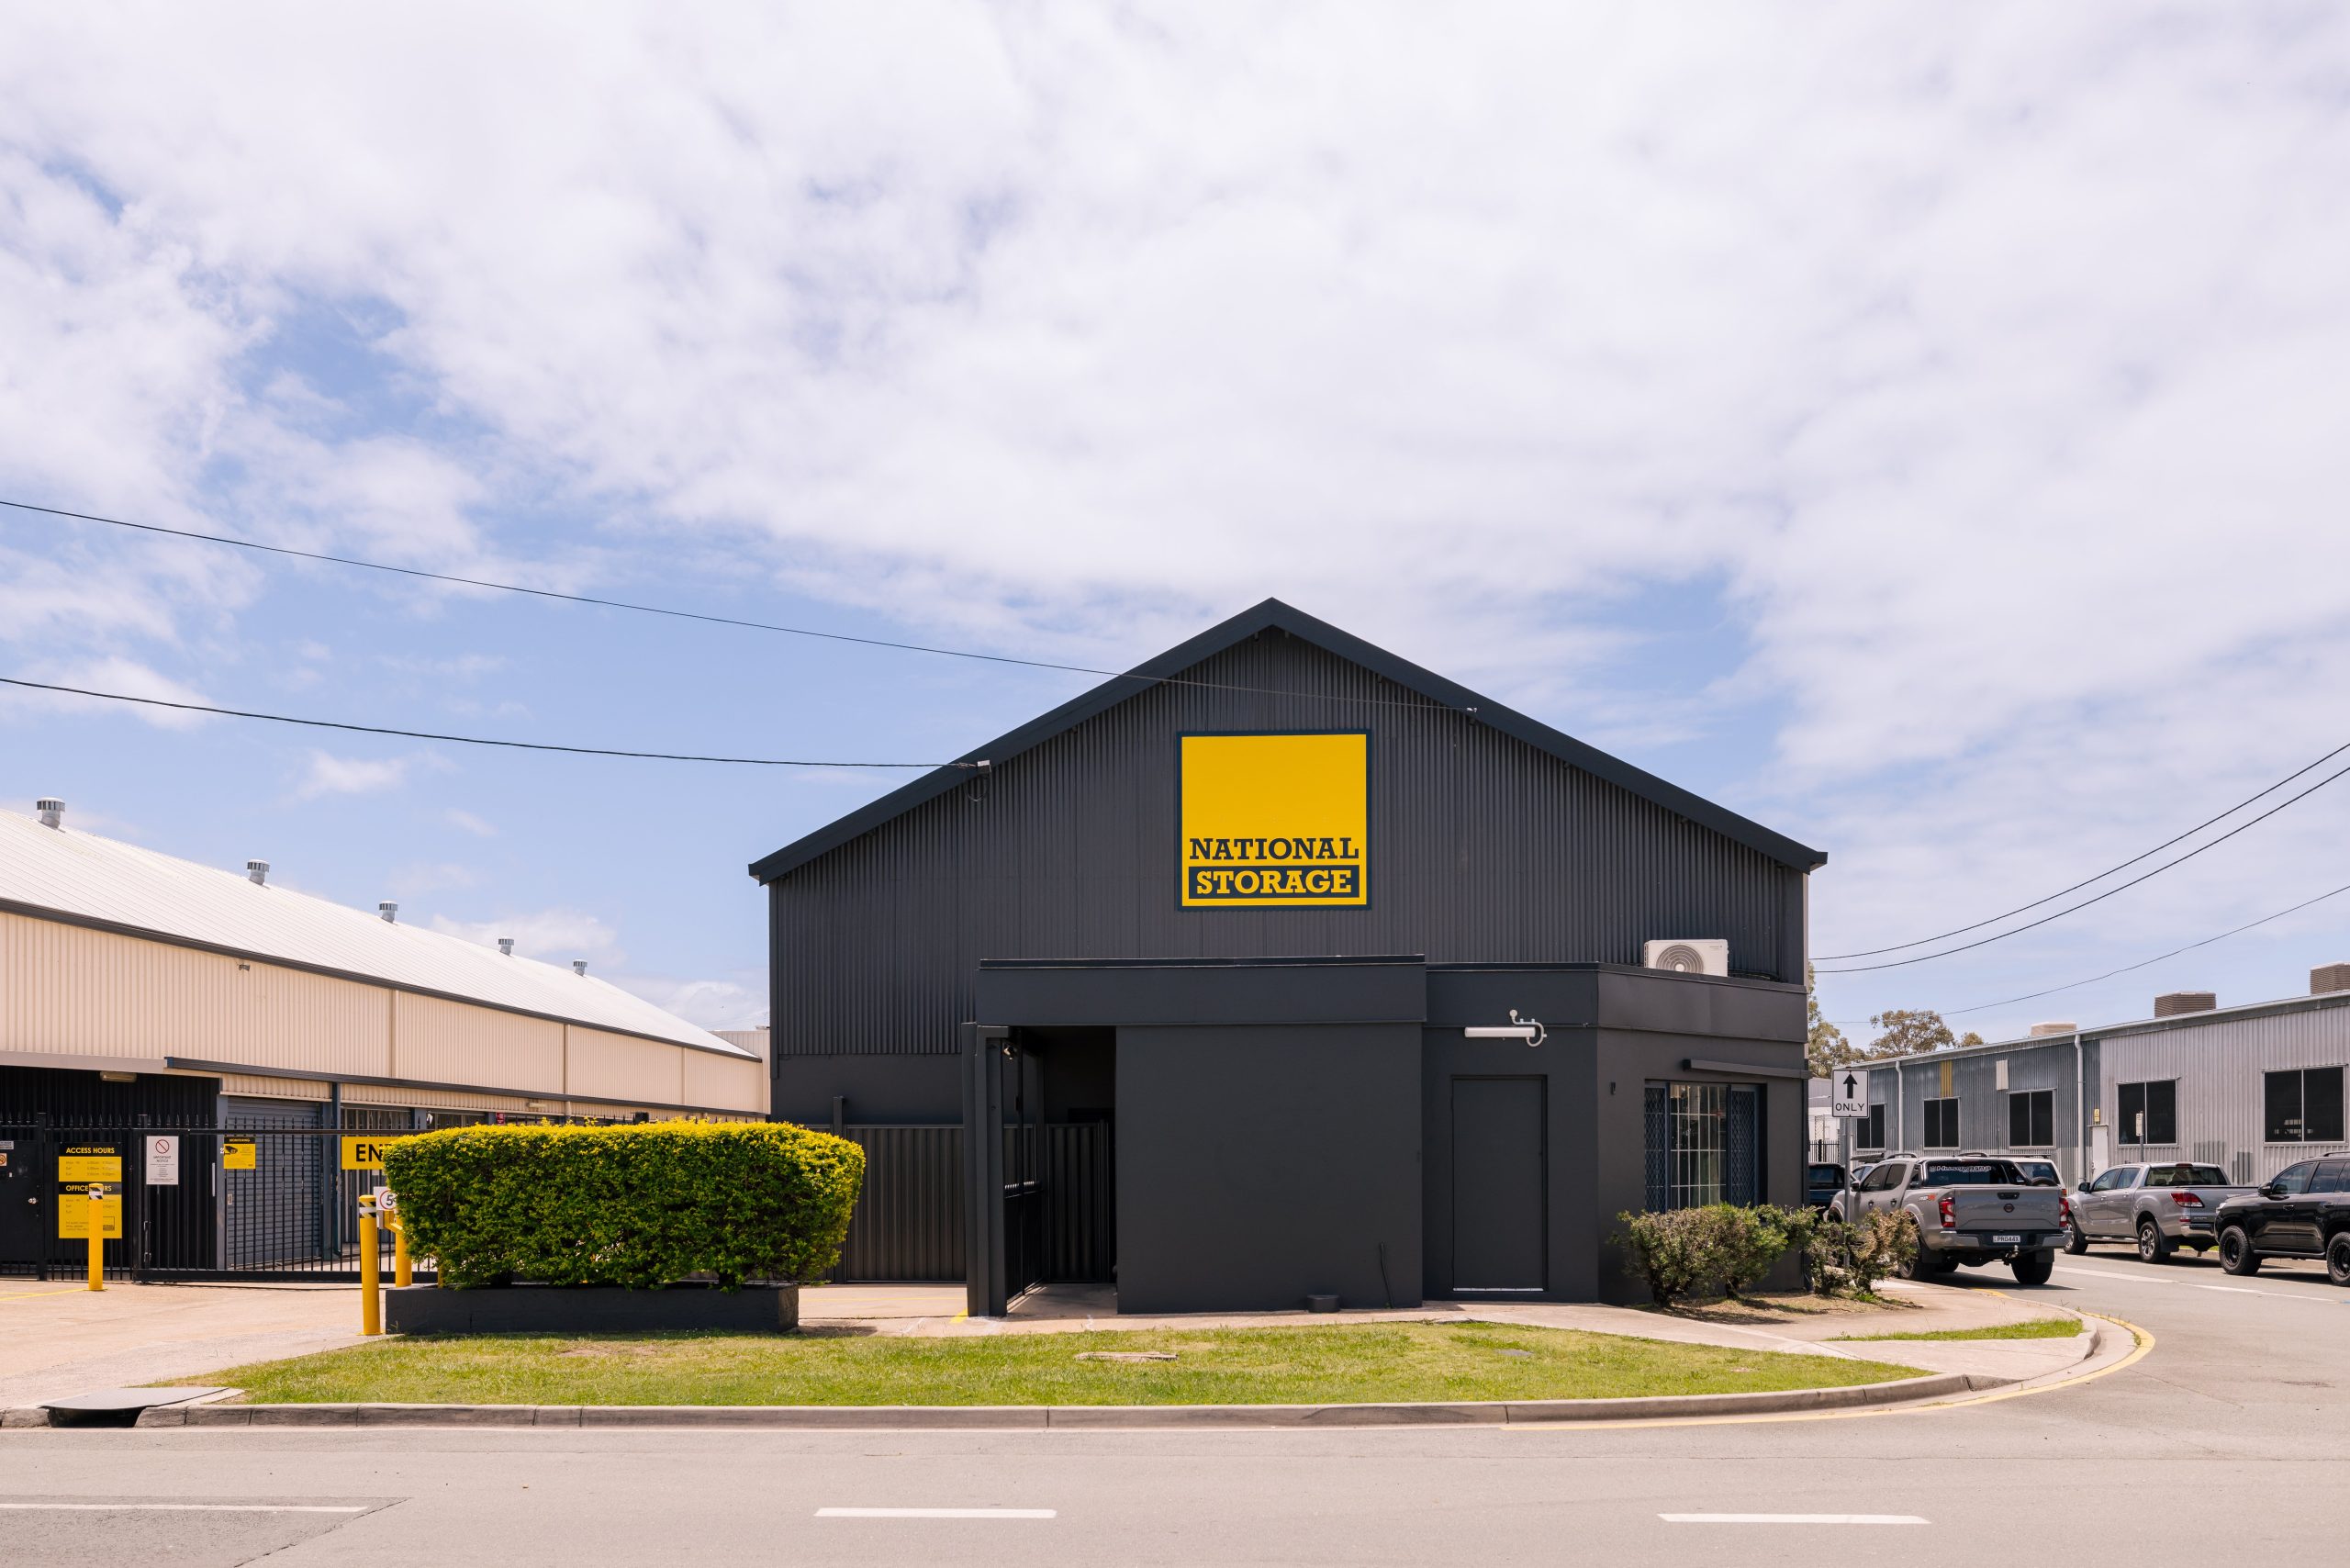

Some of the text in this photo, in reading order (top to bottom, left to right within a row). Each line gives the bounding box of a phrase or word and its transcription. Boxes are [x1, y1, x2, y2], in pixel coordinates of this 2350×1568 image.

[1190, 837, 1359, 860] NATIONAL
[1196, 869, 1352, 894] STORAGE
[1835, 1103, 1865, 1112] ONLY
[386, 1194, 394, 1206] 5
